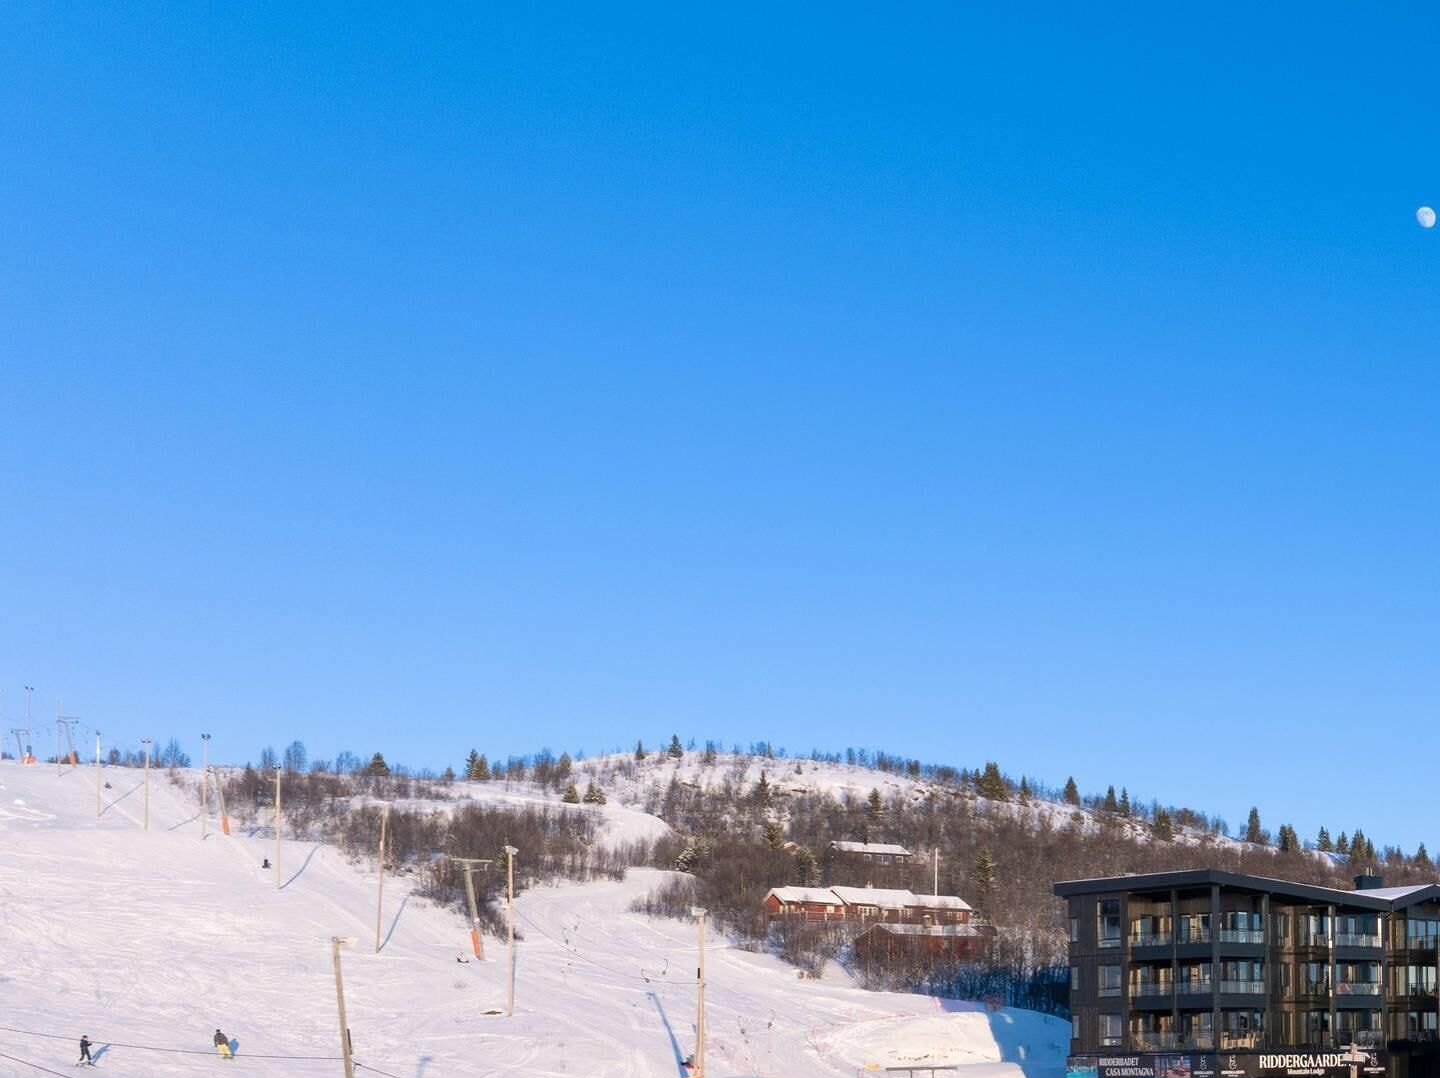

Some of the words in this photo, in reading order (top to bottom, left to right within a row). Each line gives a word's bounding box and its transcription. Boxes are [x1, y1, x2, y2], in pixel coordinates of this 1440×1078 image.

[1259, 1053, 1351, 1068] RIDDERGAARDE
[1106, 1068, 1121, 1076] CASA
[1121, 1068, 1154, 1076] MONTAGNA
